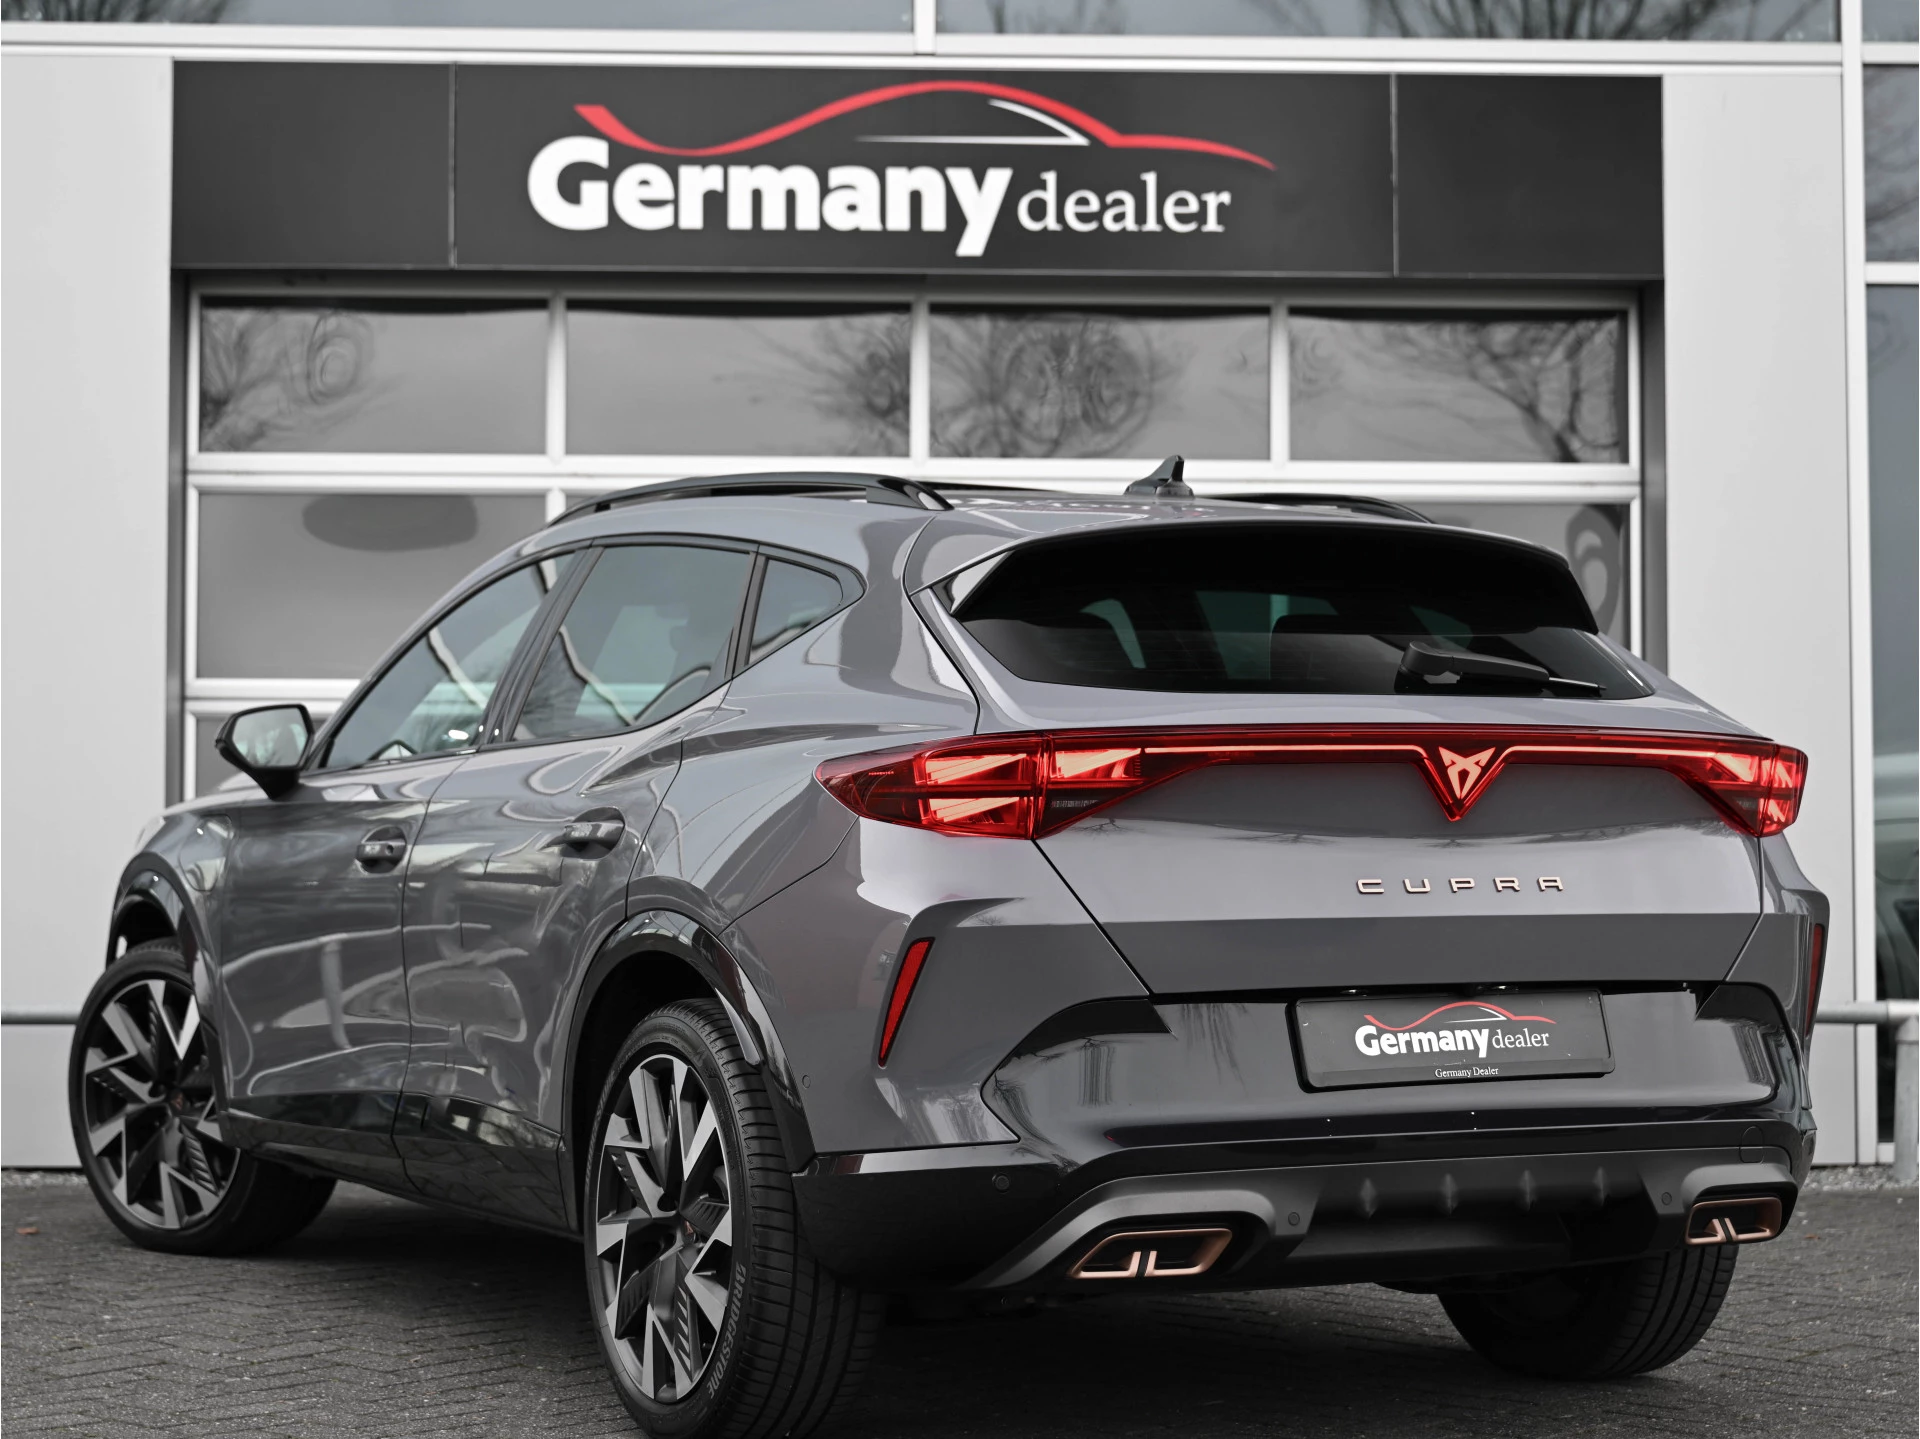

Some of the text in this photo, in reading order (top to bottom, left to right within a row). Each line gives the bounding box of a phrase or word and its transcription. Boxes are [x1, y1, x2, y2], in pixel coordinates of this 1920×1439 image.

[527, 135, 1232, 257] Germany dealer
[1356, 876, 1564, 895] CUPRA
[1355, 1024, 1550, 1058] Germany dealer
[1434, 1066, 1499, 1078] Germany Dealer
[706, 1261, 747, 1399] BRIDGESTONE
